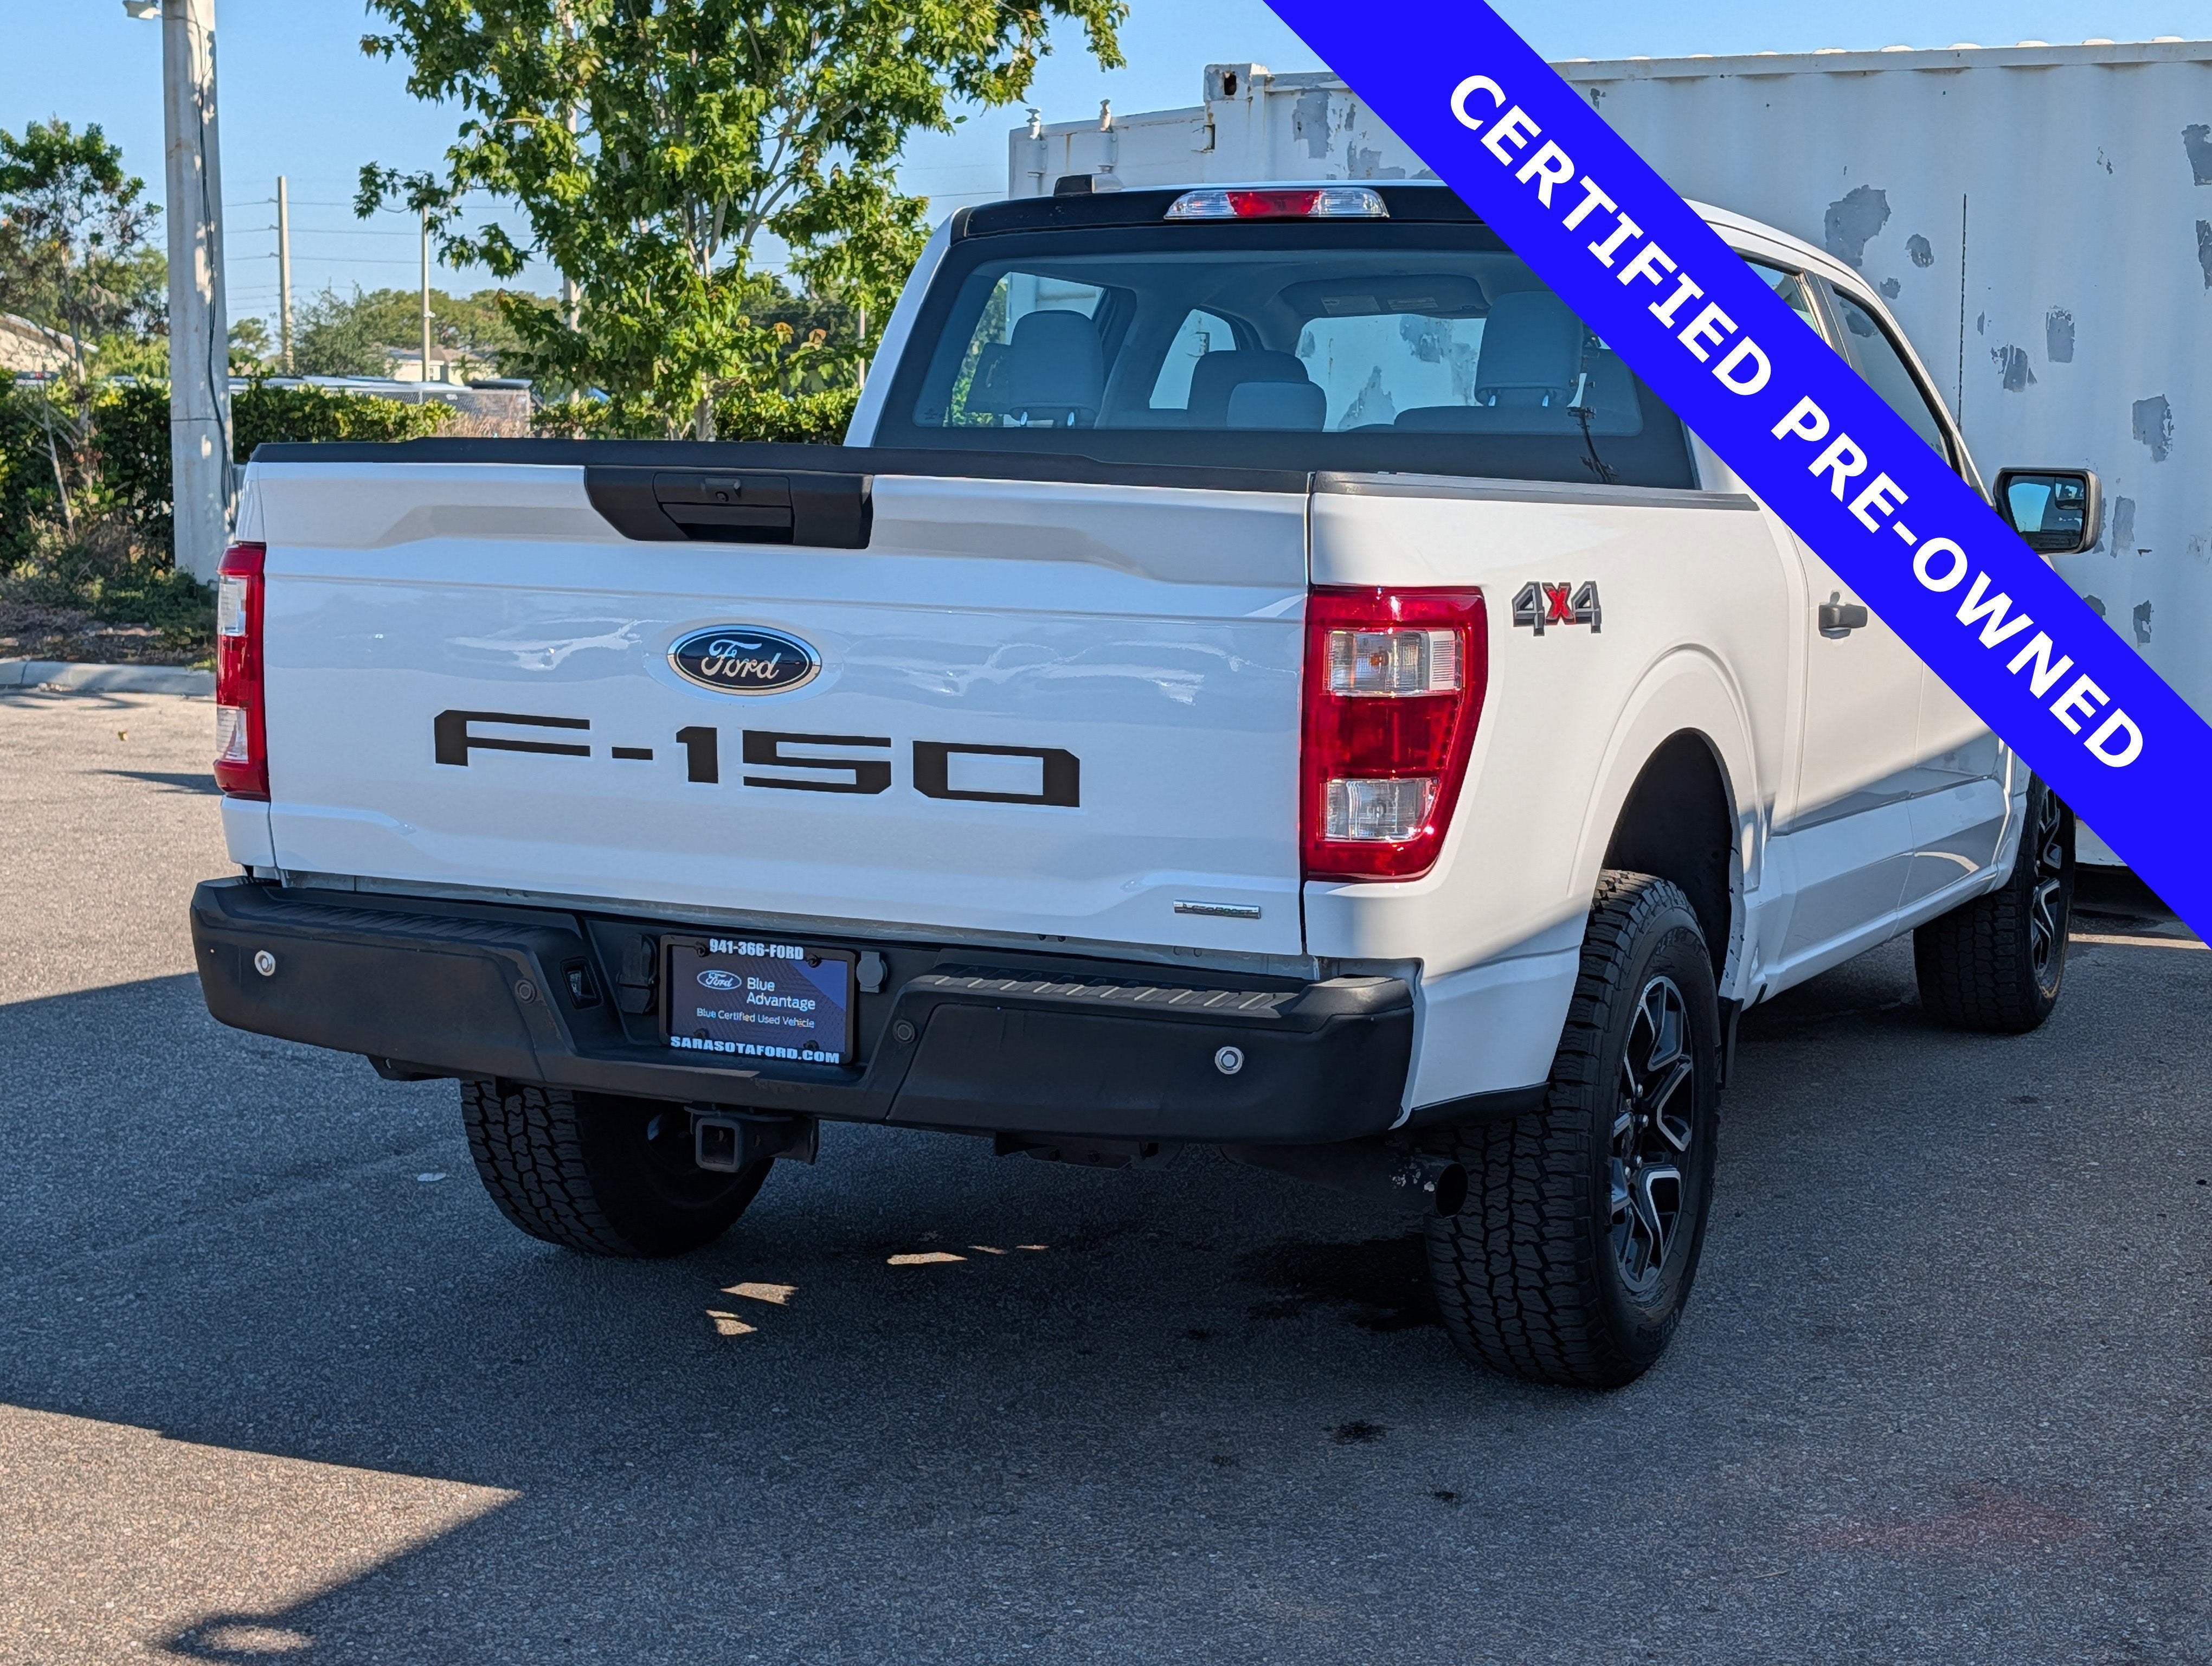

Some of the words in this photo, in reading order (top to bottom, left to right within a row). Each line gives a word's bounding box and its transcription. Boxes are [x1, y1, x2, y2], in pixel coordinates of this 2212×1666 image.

[701, 639, 781, 679] Ford
[434, 709, 1080, 808] F-150
[709, 938, 803, 960] 941-366-FORD
[705, 972, 735, 988] Ford
[747, 977, 775, 992] Blue
[746, 992, 816, 1012] Advantage
[697, 1008, 716, 1019] Blue
[718, 1009, 756, 1023] Certified
[758, 1014, 780, 1025] Used
[782, 1016, 815, 1028] Vehicle
[670, 1036, 840, 1064] SARASOTAFORD.COM
